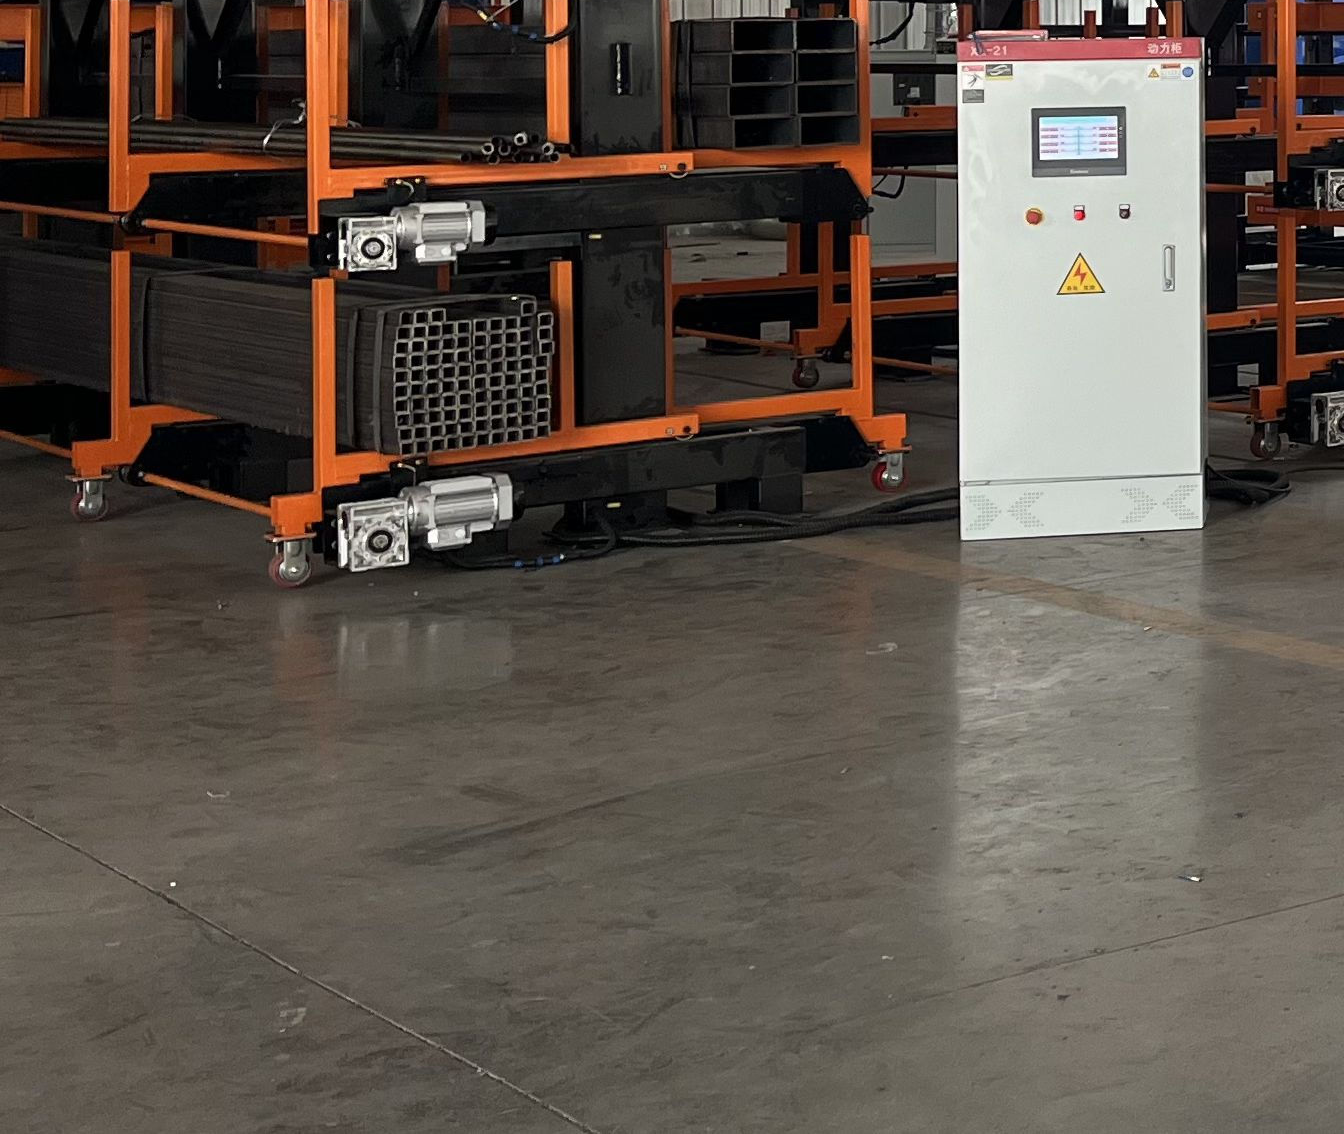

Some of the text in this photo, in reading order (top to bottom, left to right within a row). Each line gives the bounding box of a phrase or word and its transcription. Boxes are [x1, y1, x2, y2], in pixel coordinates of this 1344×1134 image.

[970, 47, 1008, 57] X-21
[1147, 42, 1183, 55] 动力柜
